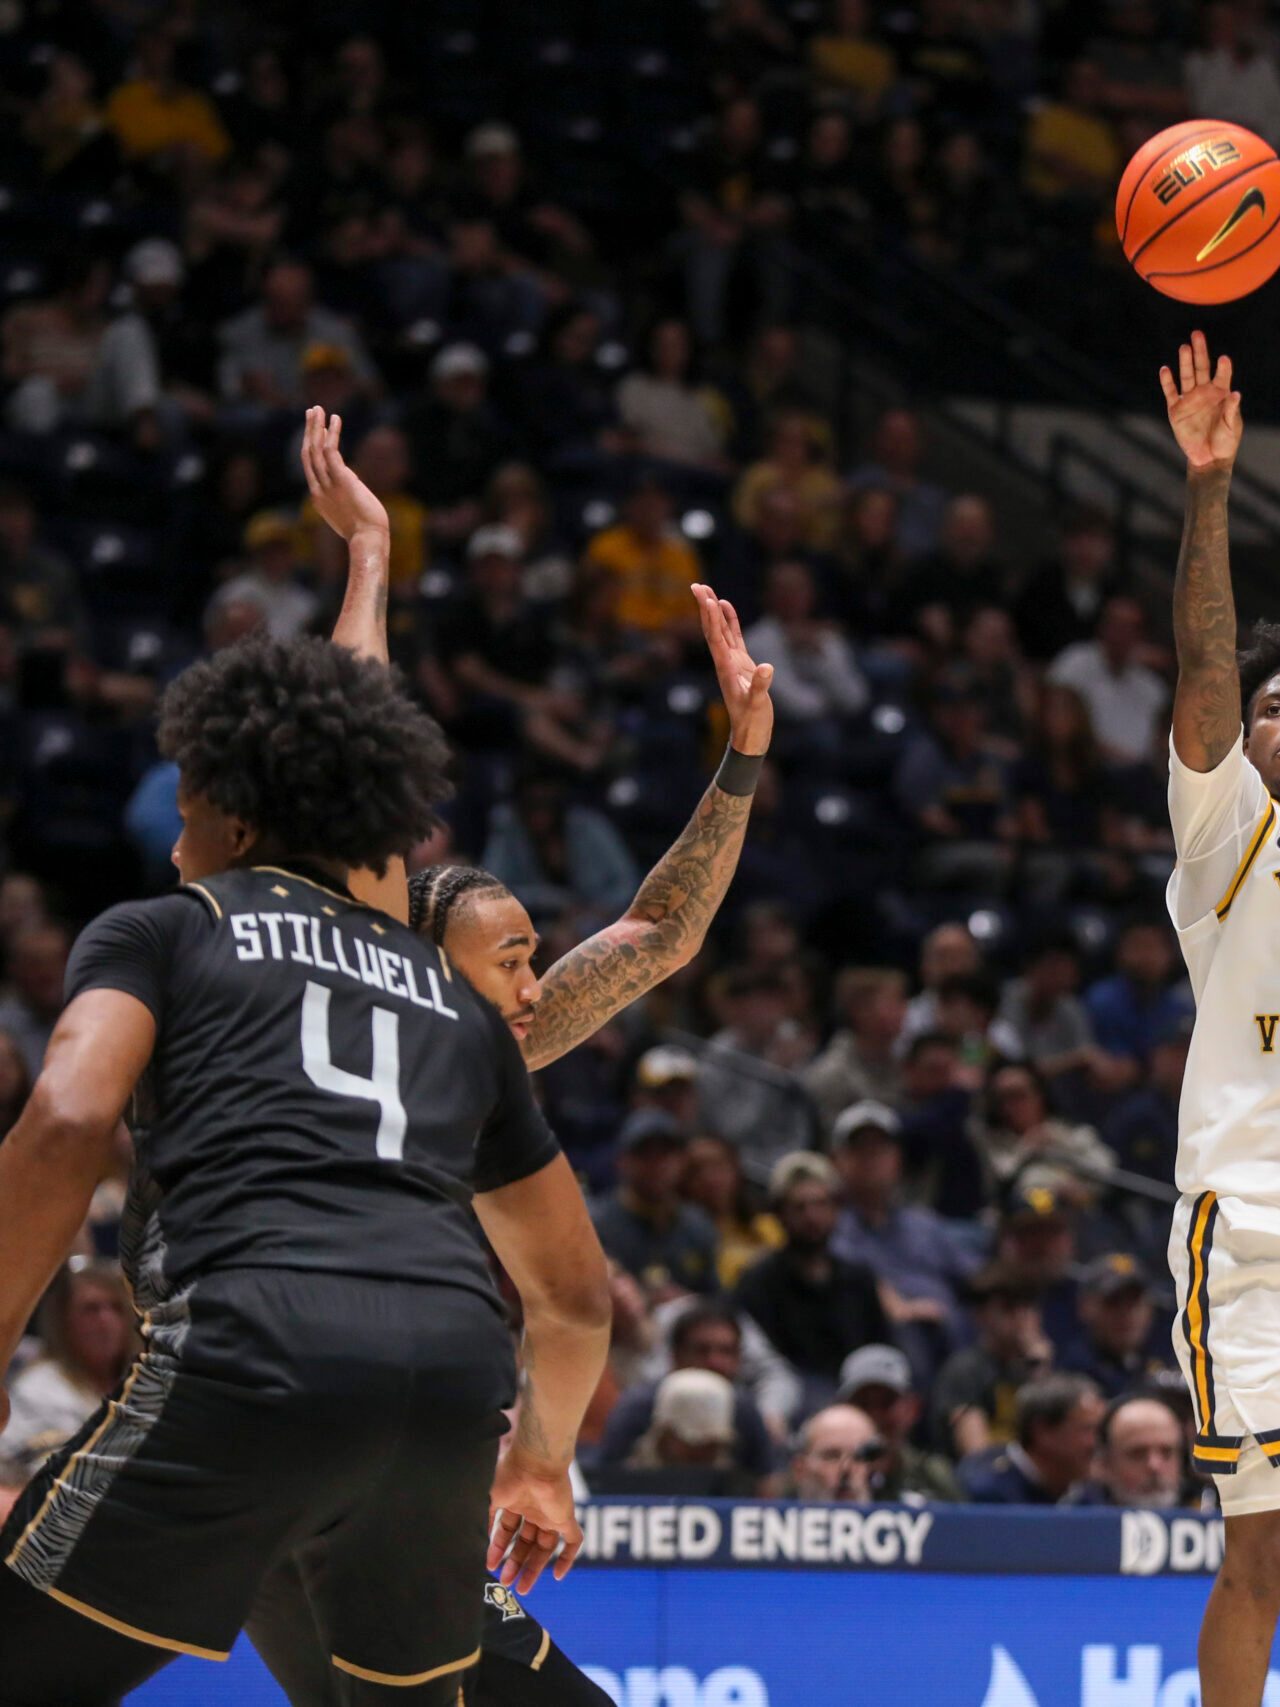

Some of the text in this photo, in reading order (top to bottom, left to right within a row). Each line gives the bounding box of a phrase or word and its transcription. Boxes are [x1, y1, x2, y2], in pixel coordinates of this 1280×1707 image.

[1153, 139, 1242, 205] ELITE
[229, 911, 459, 1021] STILLWELL
[300, 979, 408, 1161] 4
[730, 1506, 934, 1565] ENERGY
